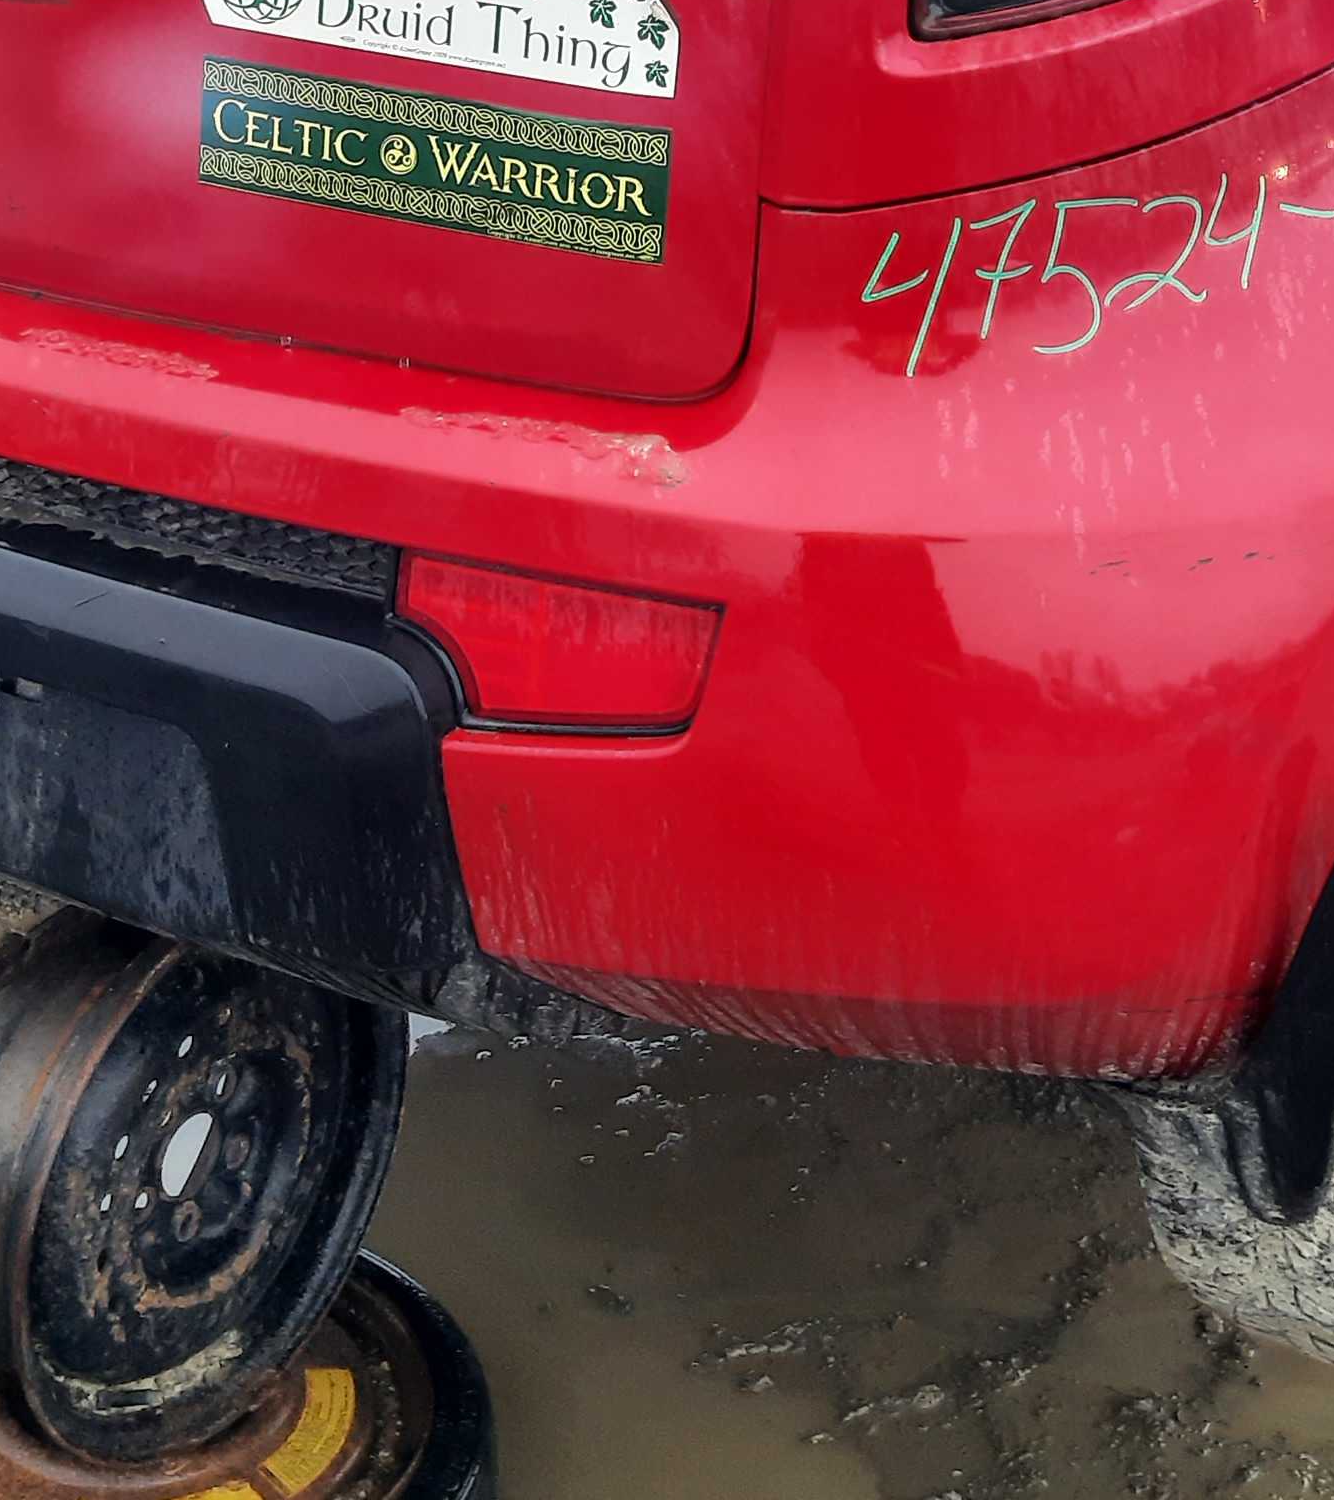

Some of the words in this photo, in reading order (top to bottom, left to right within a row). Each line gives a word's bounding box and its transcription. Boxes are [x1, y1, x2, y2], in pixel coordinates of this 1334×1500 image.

[476, 1, 632, 88] Thing
[212, 98, 370, 167] CELTIC
[428, 134, 654, 218] WARRIOR
